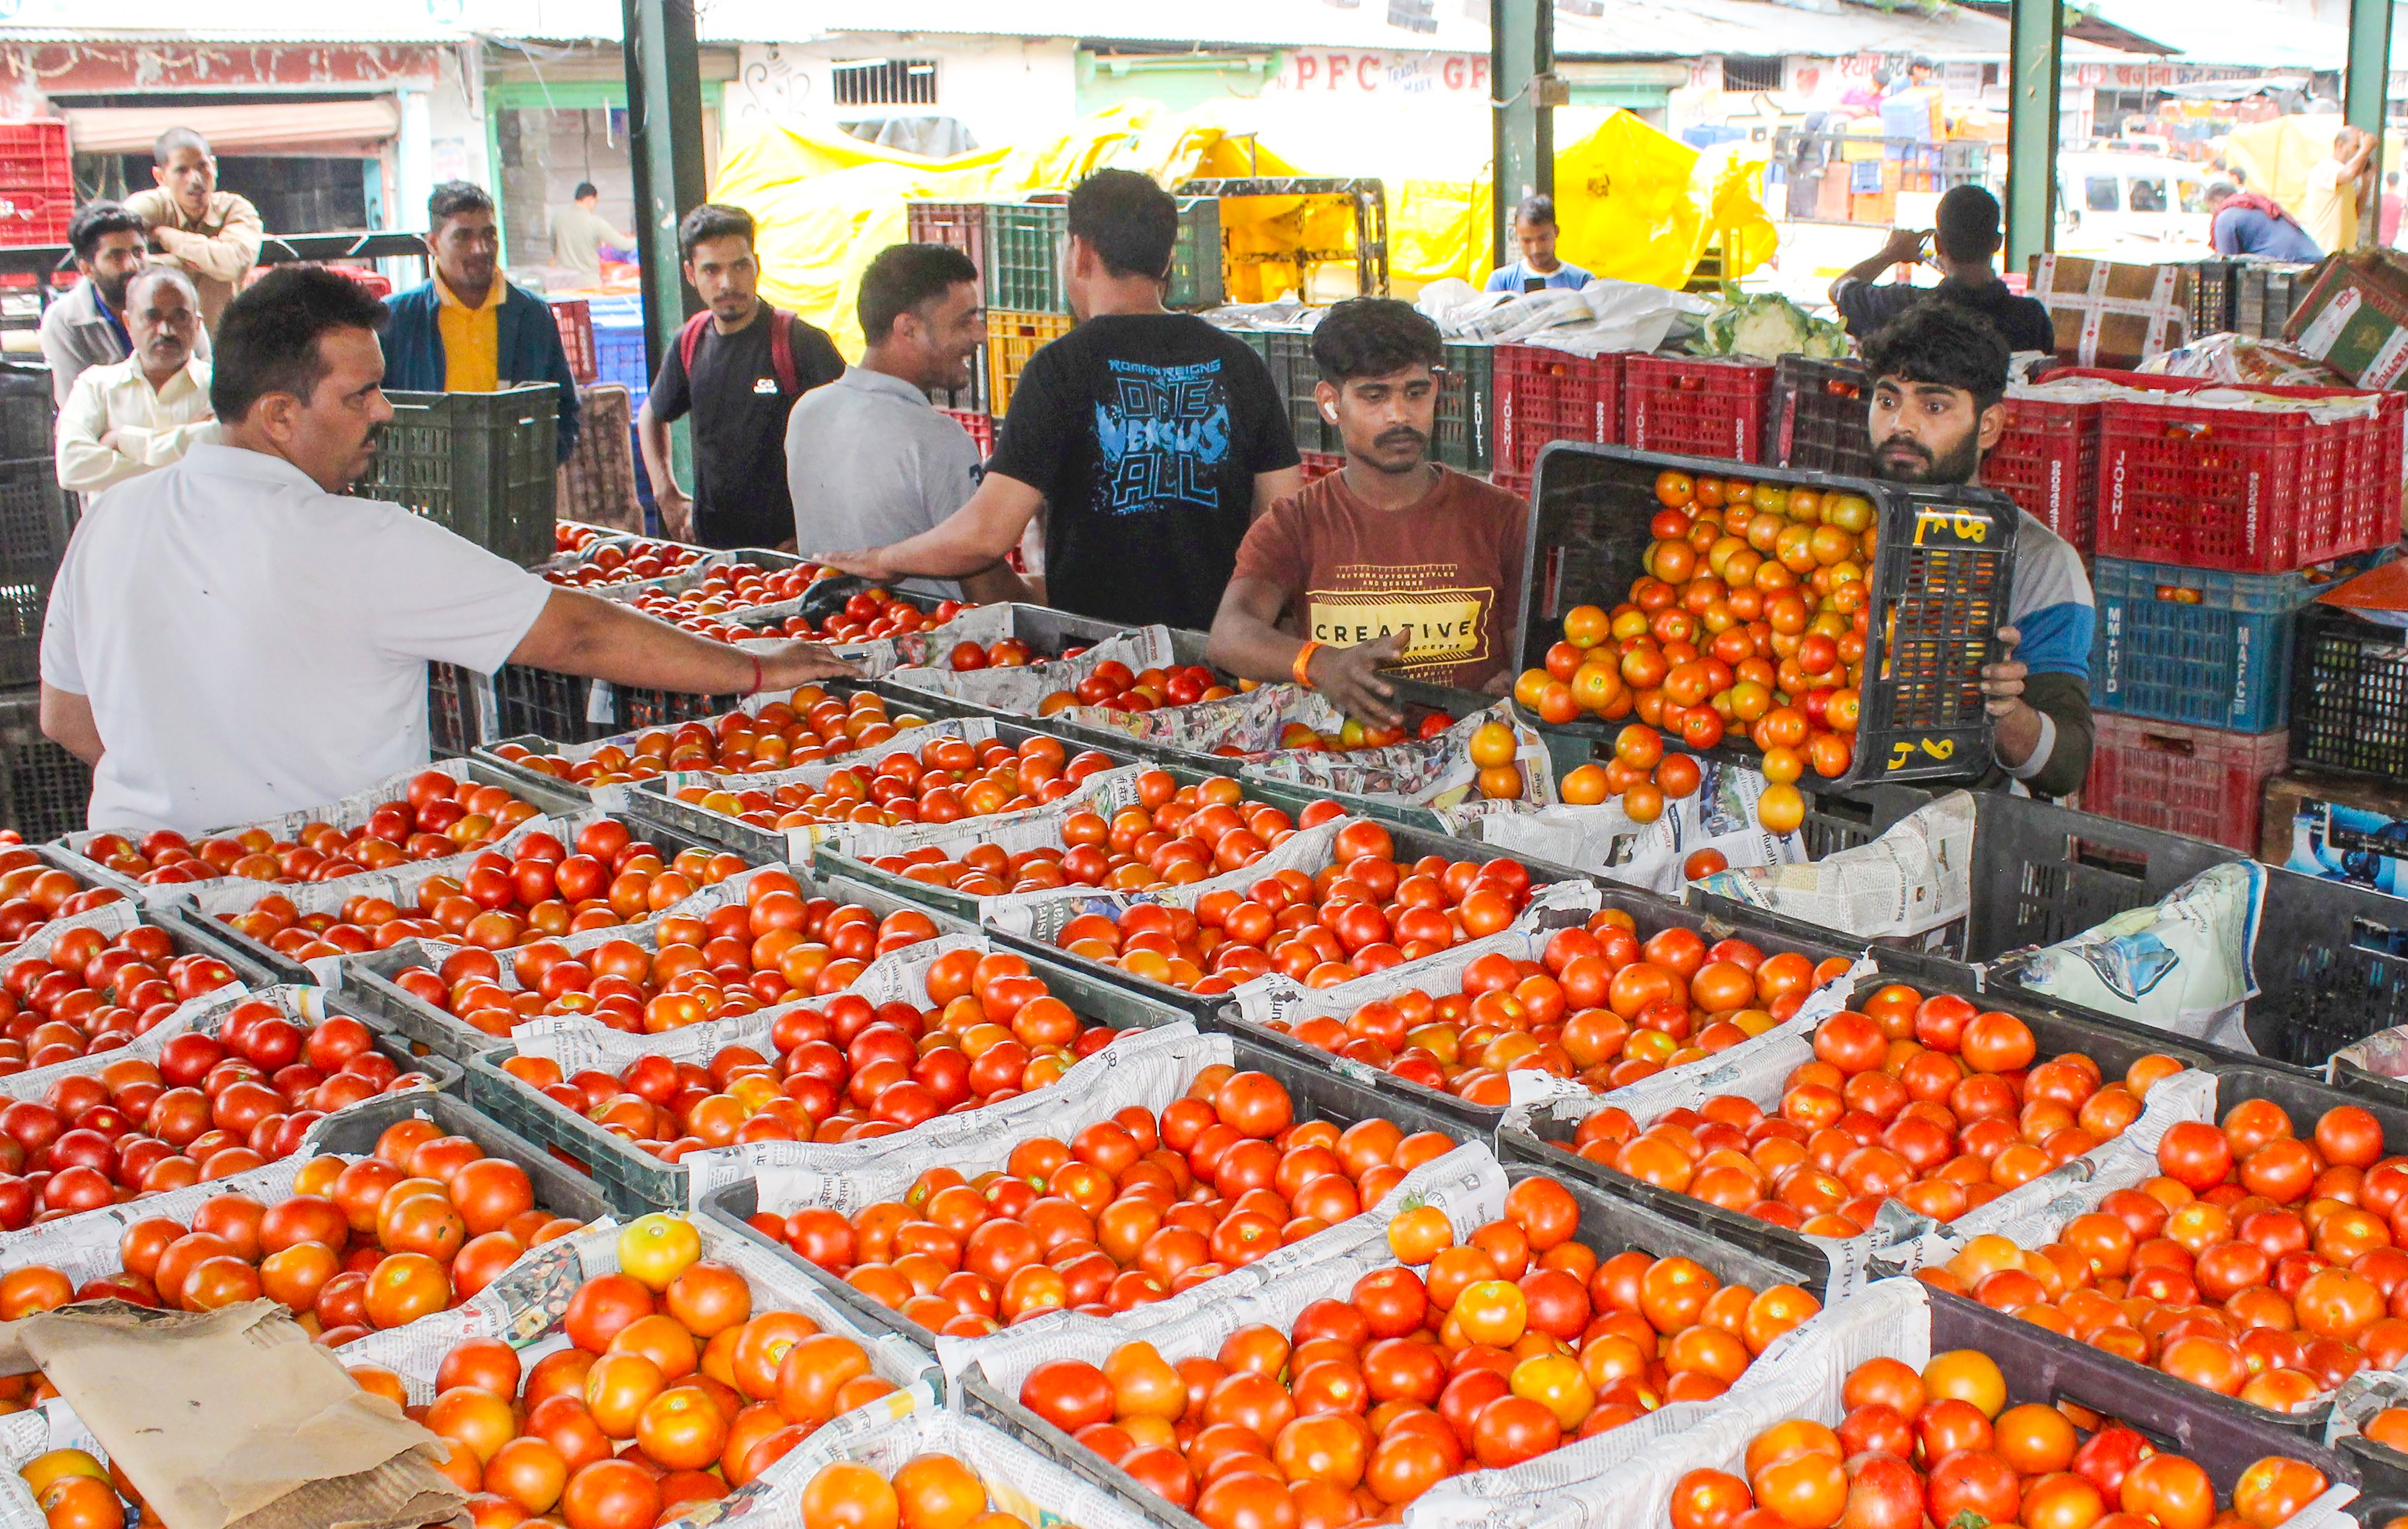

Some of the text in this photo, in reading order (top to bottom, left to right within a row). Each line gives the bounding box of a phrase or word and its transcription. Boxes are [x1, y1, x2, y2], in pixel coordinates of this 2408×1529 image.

[1296, 55, 1380, 91] PFC
[1385, 60, 1419, 83] TRADE
[1117, 377, 1214, 418] ONE
[1095, 402, 1230, 465] VERSUS
[1475, 392, 1483, 457] FRUITS
[1503, 392, 1512, 457] JOSHI
[1112, 453, 1219, 508] ALL
[2112, 451, 2125, 530] JOSHI
[1404, 644, 1460, 652] ONCEPTS
[1660, 820, 1672, 849] CAPSULE
[1761, 833, 1777, 857] Rural
